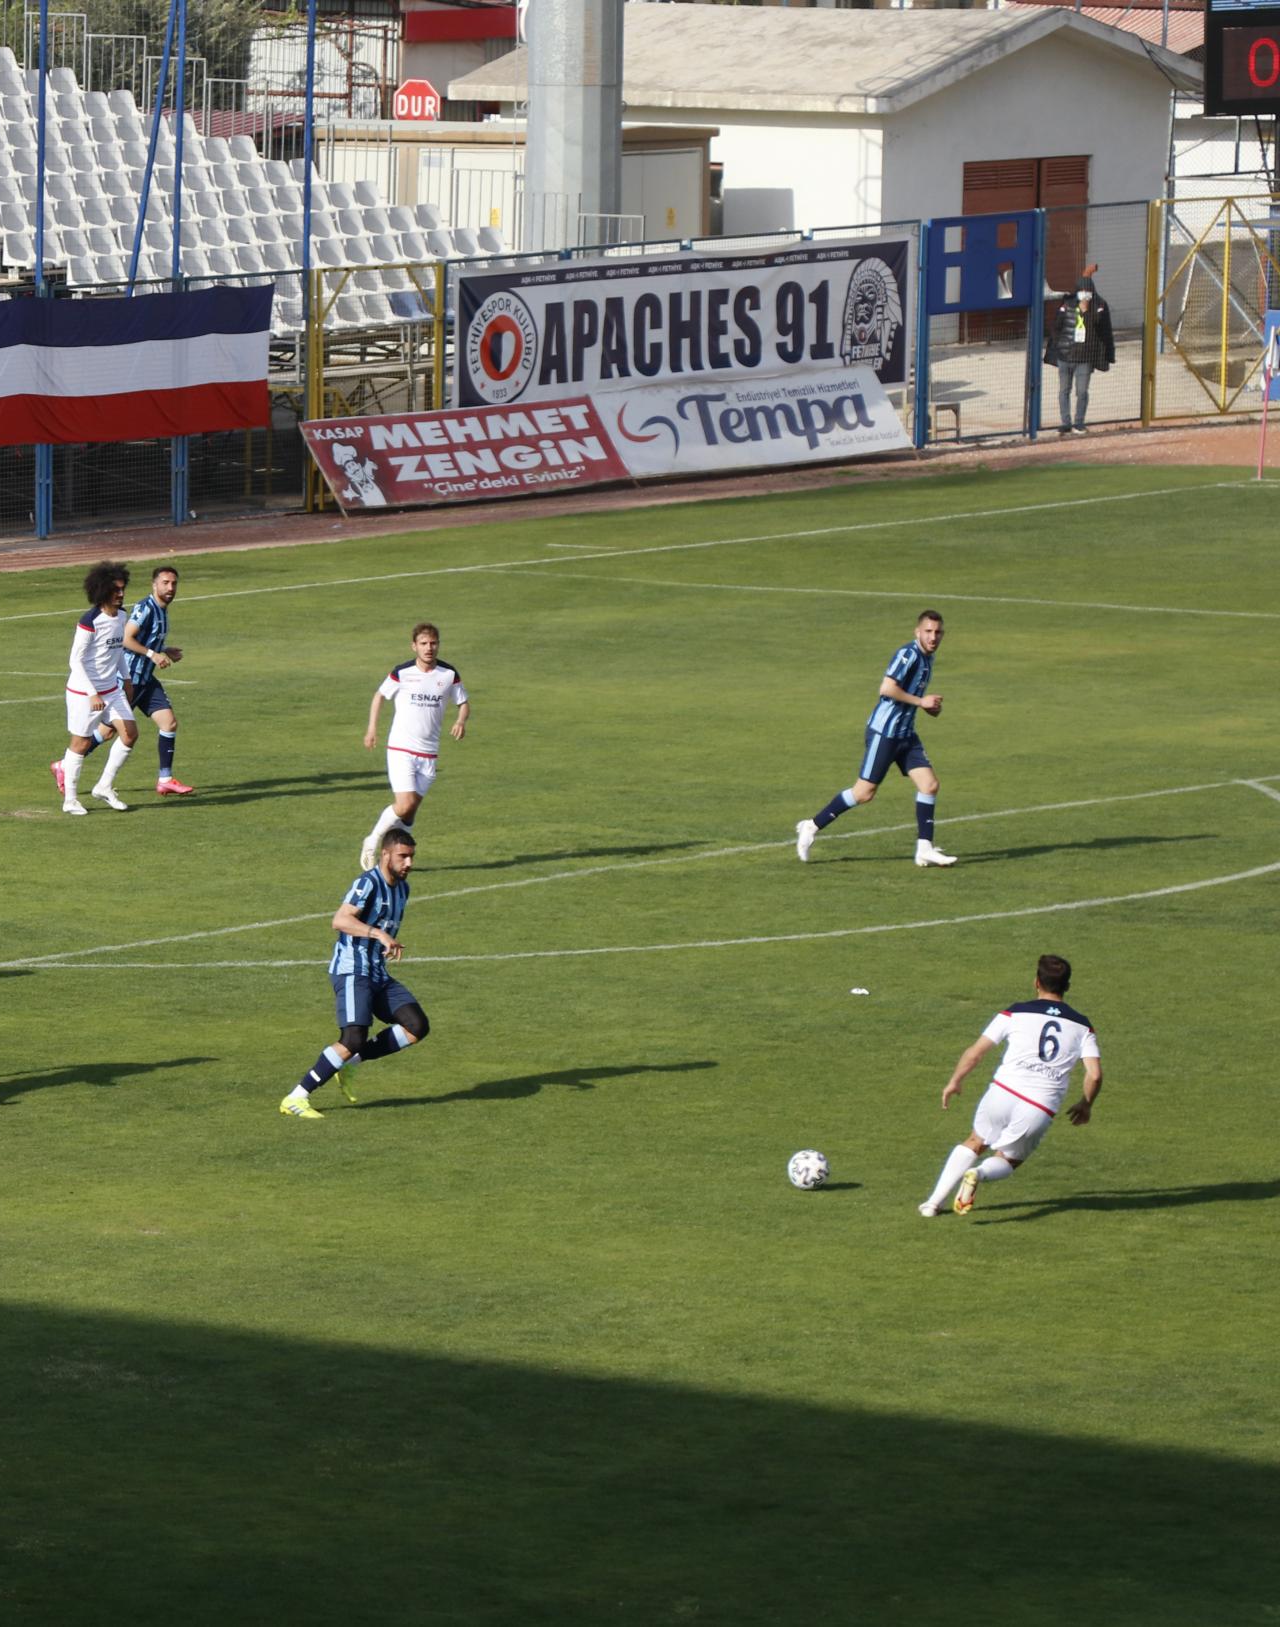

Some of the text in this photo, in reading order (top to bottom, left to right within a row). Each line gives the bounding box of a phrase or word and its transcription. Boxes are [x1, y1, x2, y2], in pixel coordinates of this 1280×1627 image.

[397, 94, 436, 116] DUR
[538, 280, 836, 386] APACHES 91
[781, 386, 817, 398] Temizlik
[818, 379, 860, 394] Hizmetleri
[313, 425, 364, 441] KASAP
[370, 405, 590, 450] MEHMET
[677, 392, 875, 450] Tempa
[1039, 1020, 1061, 1062] 6
